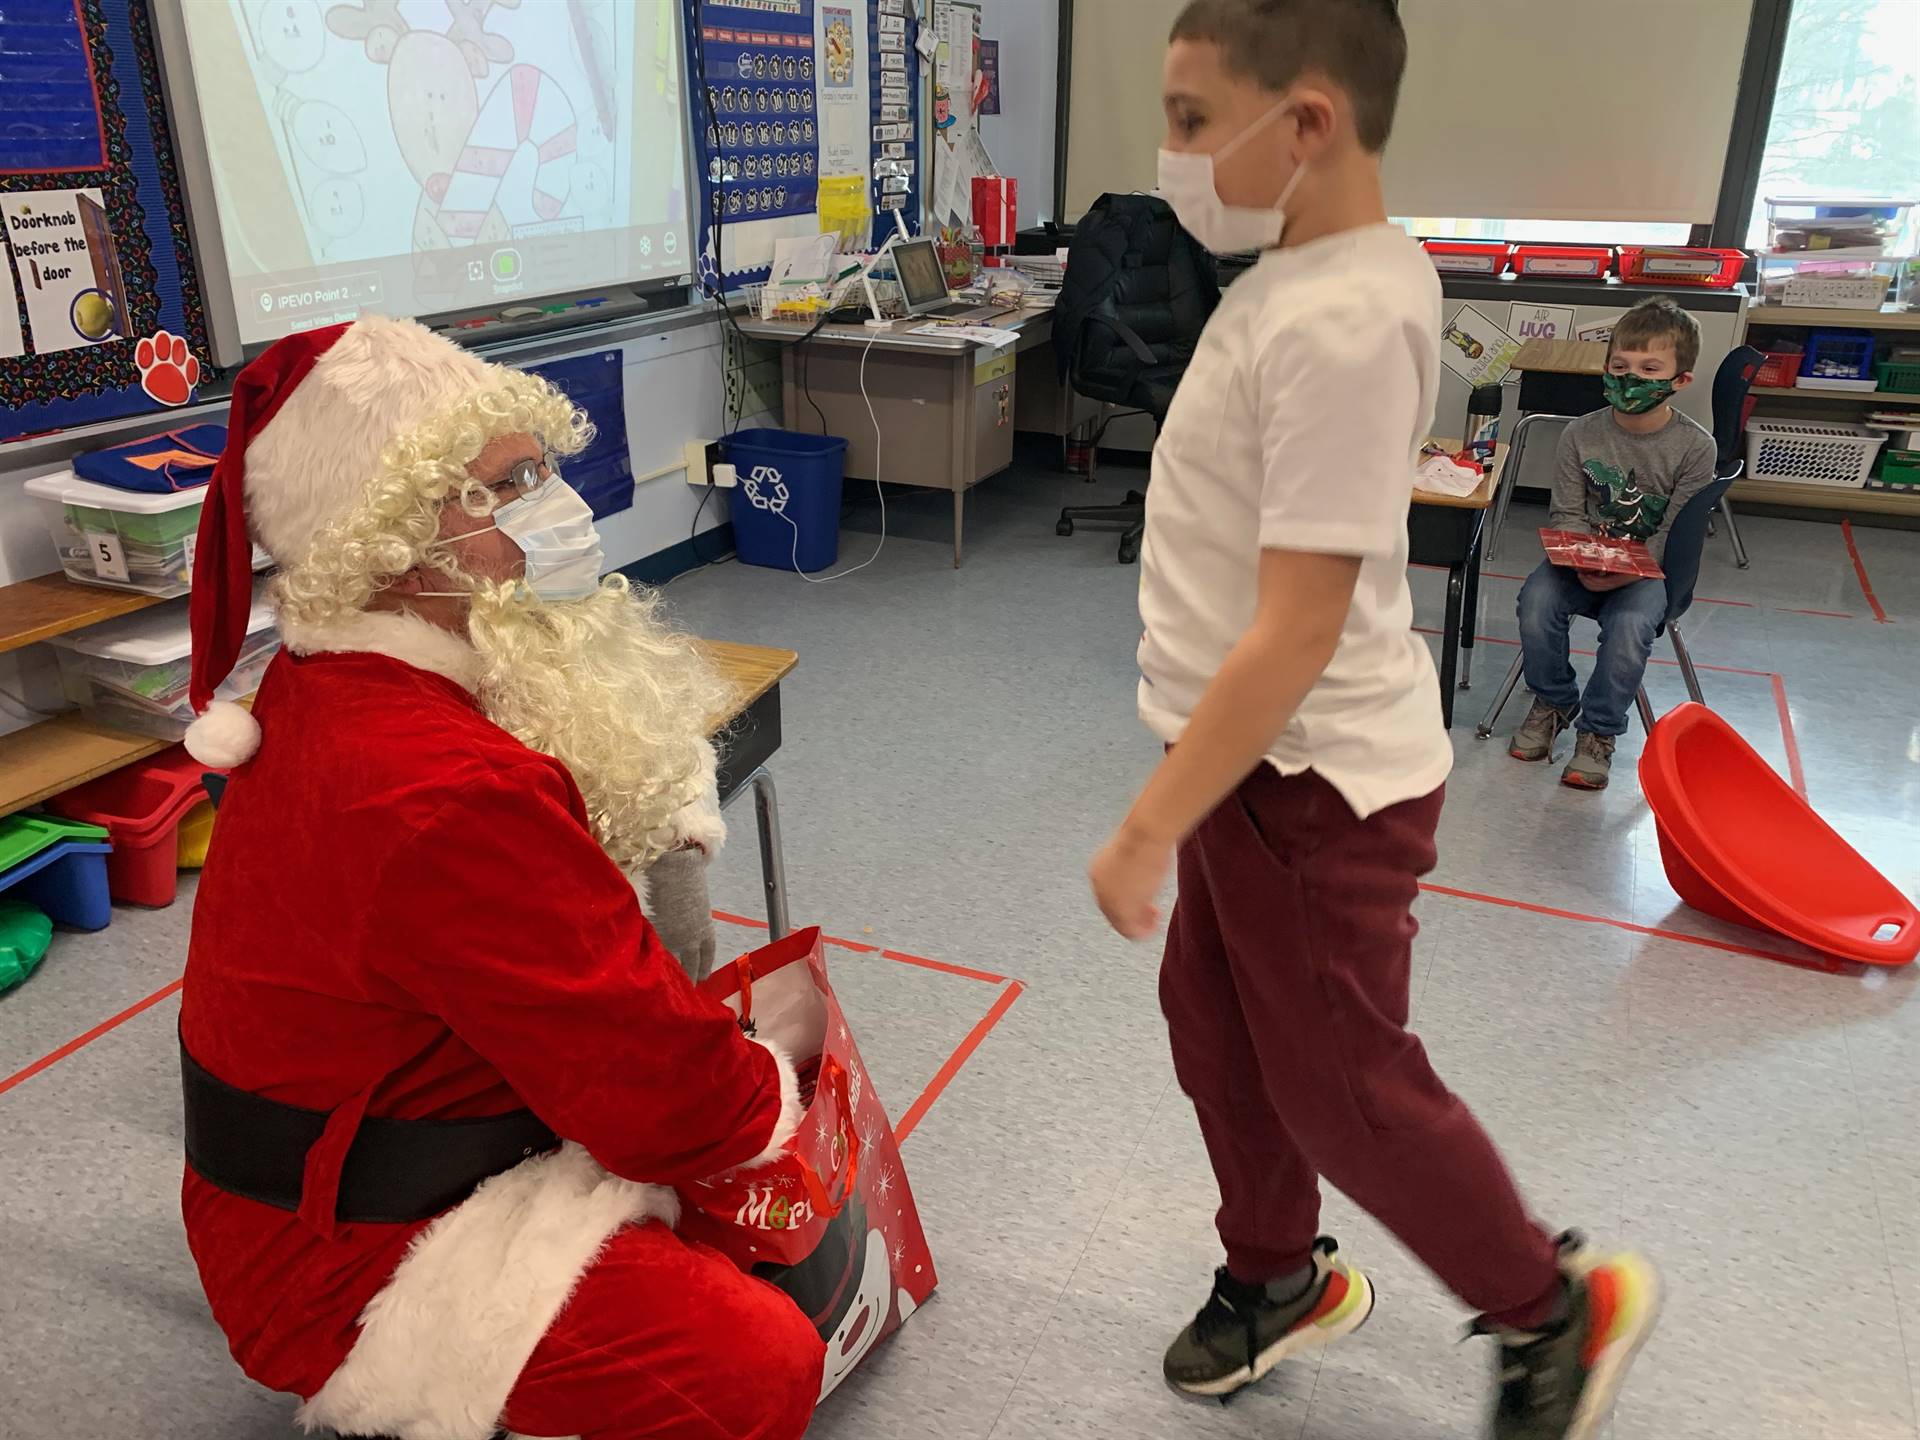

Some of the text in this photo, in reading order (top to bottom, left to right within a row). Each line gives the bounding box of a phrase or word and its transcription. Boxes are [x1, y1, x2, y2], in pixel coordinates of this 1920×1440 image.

[757, 60, 763, 76] 2
[773, 61, 779, 77] 3
[786, 62, 793, 77] 4
[803, 62, 810, 77] 5
[726, 92, 733, 108] 7
[743, 93, 749, 109] 8
[760, 94, 766, 110] 9
[773, 94, 781, 110] 10
[790, 94, 797, 109] 11
[803, 95, 812, 109] 12
[728, 128, 735, 144] 14
[745, 127, 753, 143] 15
[760, 128, 768, 142] 16
[775, 127, 783, 143] 17
[791, 125, 799, 142] 18
[805, 124, 812, 139] 19
[10, 211, 76, 230] Doorknob
[13, 236, 87, 258] before the
[43, 266, 71, 281] door
[278, 292, 313, 309] IPEVO
[315, 288, 341, 303] Point
[341, 287, 349, 299] 2
[1534, 309, 1550, 321] AIR
[1518, 320, 1556, 339] HUG
[98, 543, 112, 562] 5
